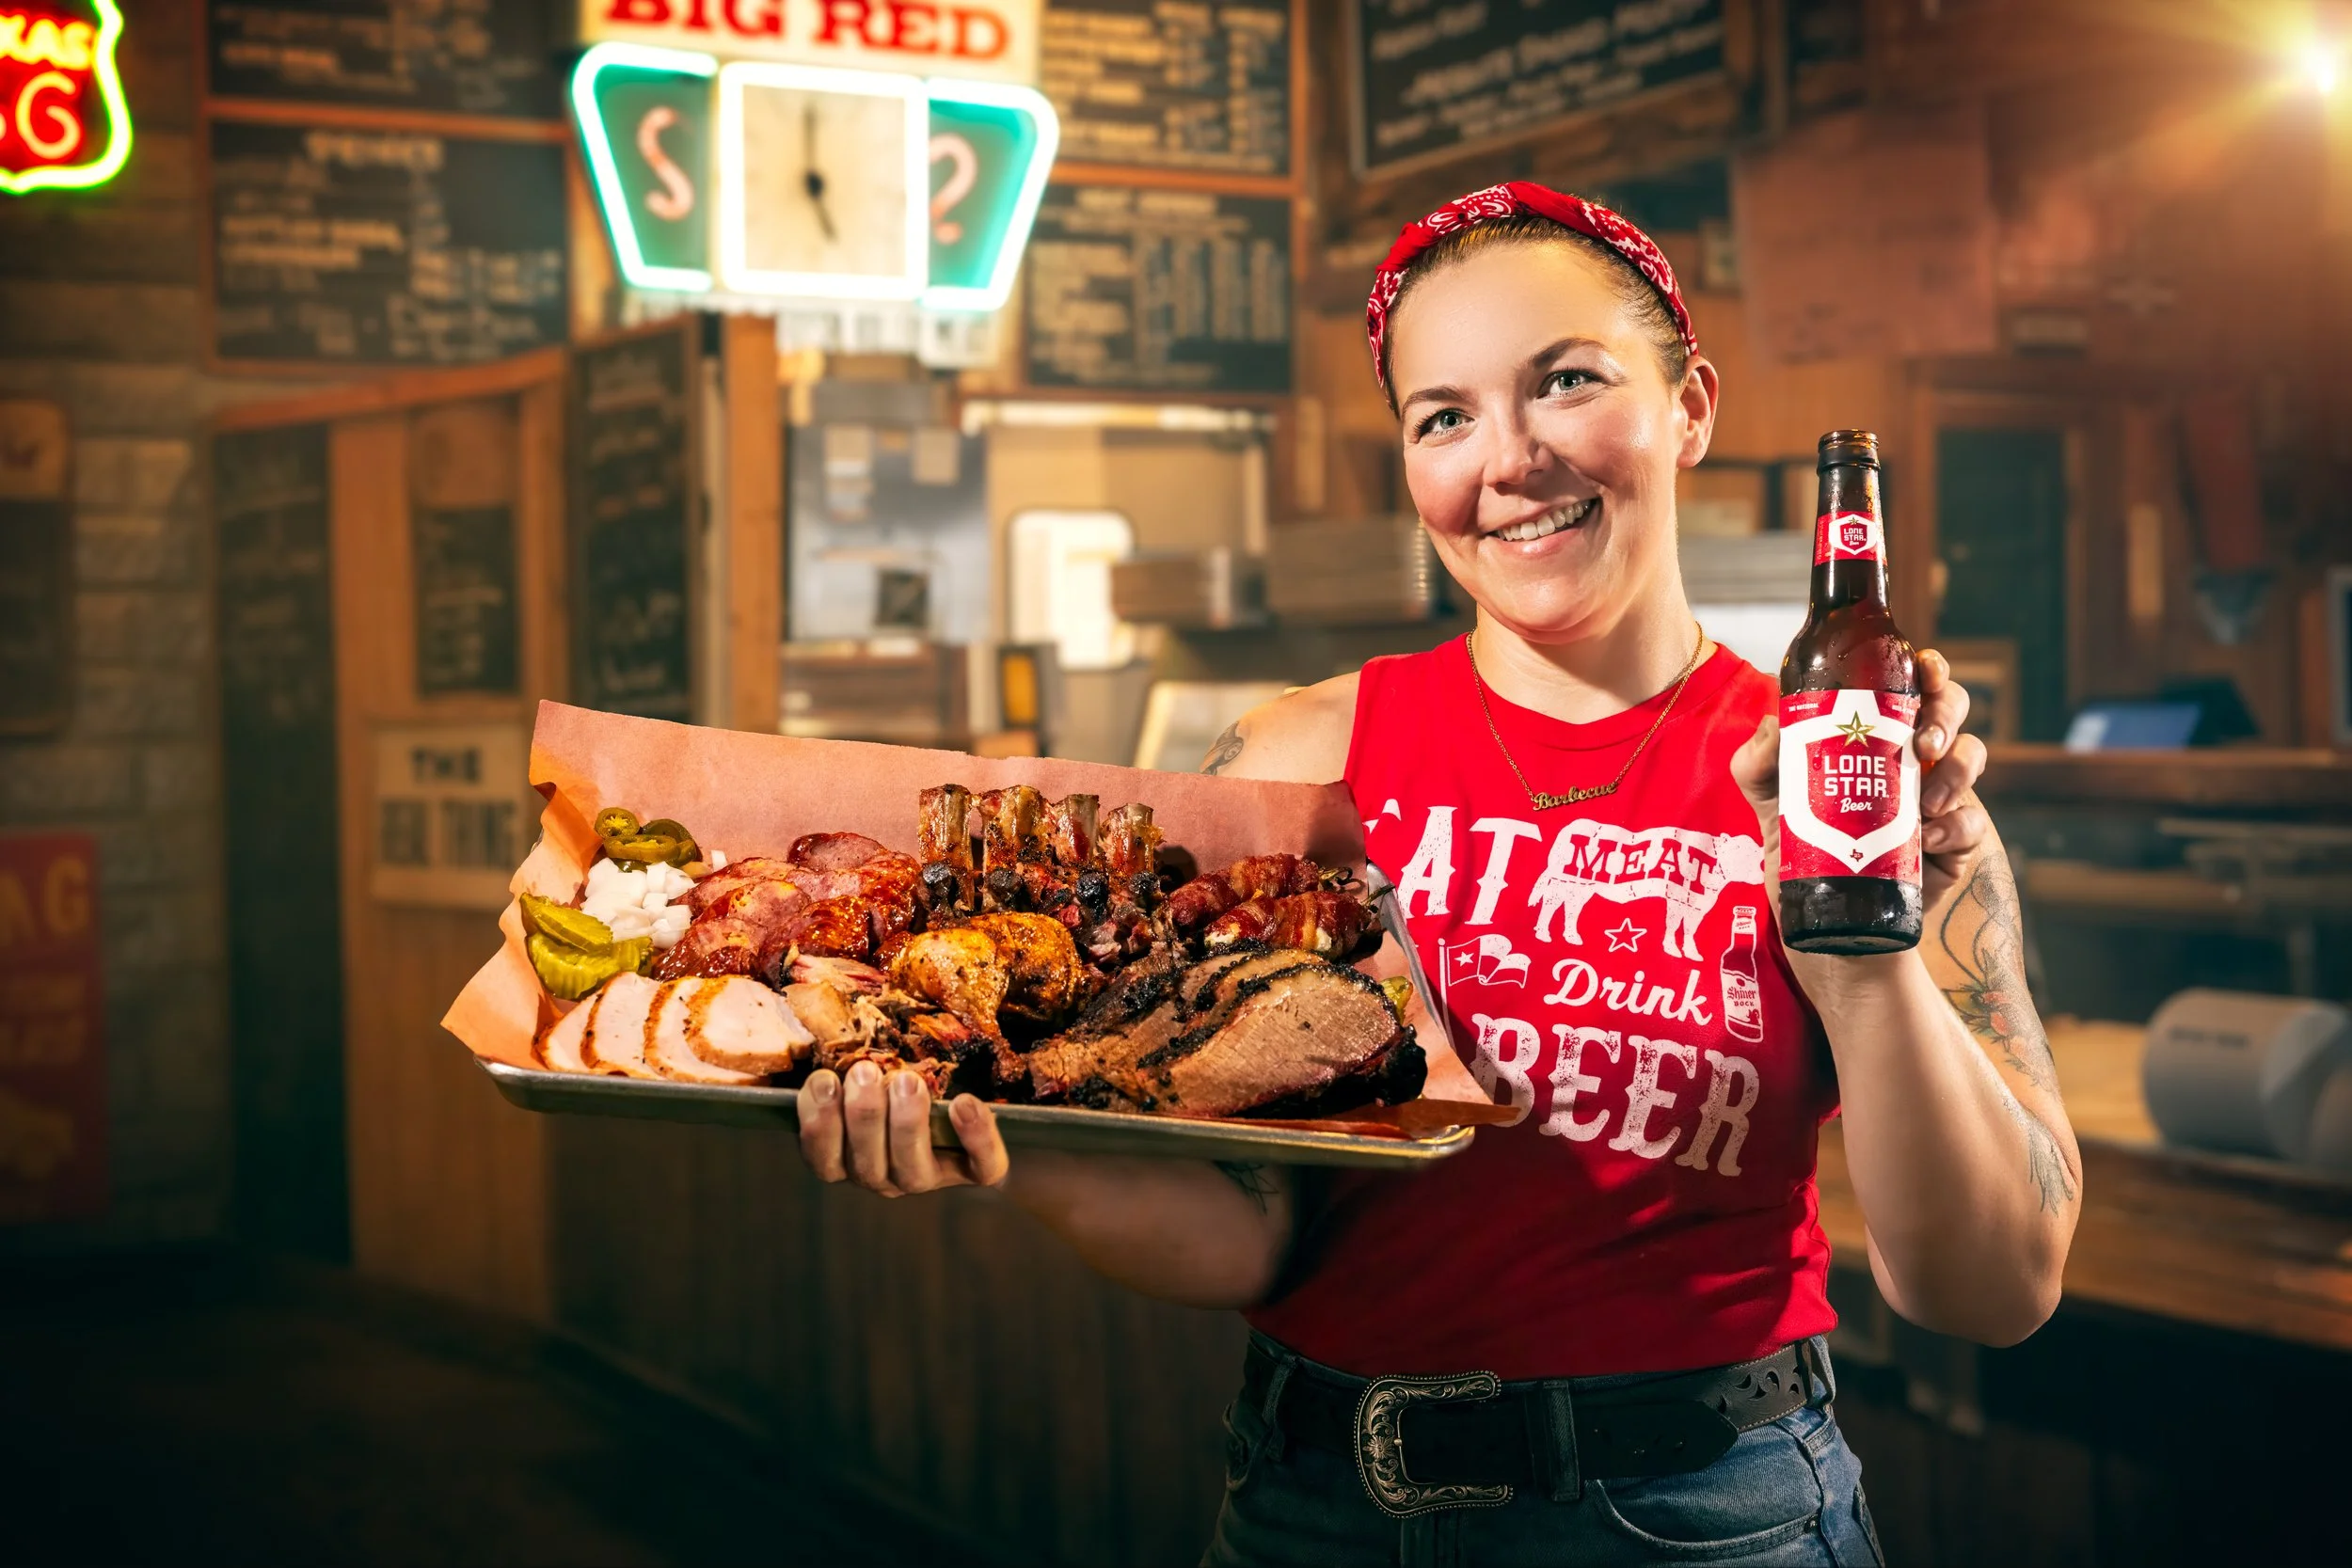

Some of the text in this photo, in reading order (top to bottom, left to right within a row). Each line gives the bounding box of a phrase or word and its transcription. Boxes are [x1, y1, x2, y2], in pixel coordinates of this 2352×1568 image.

[813, 0, 1009, 60] RED
[0, 70, 81, 160] 6
[1824, 754, 1886, 776] LONE
[1824, 777, 1887, 798] STAR
[1533, 782, 1617, 812] Barbecue
[1840, 798, 1872, 813] Beer
[1364, 799, 1720, 927] AT MEAT
[1543, 958, 1712, 1026] Drink
[1727, 987, 1756, 1000] Shiner
[1470, 1012, 1760, 1177] BEER
